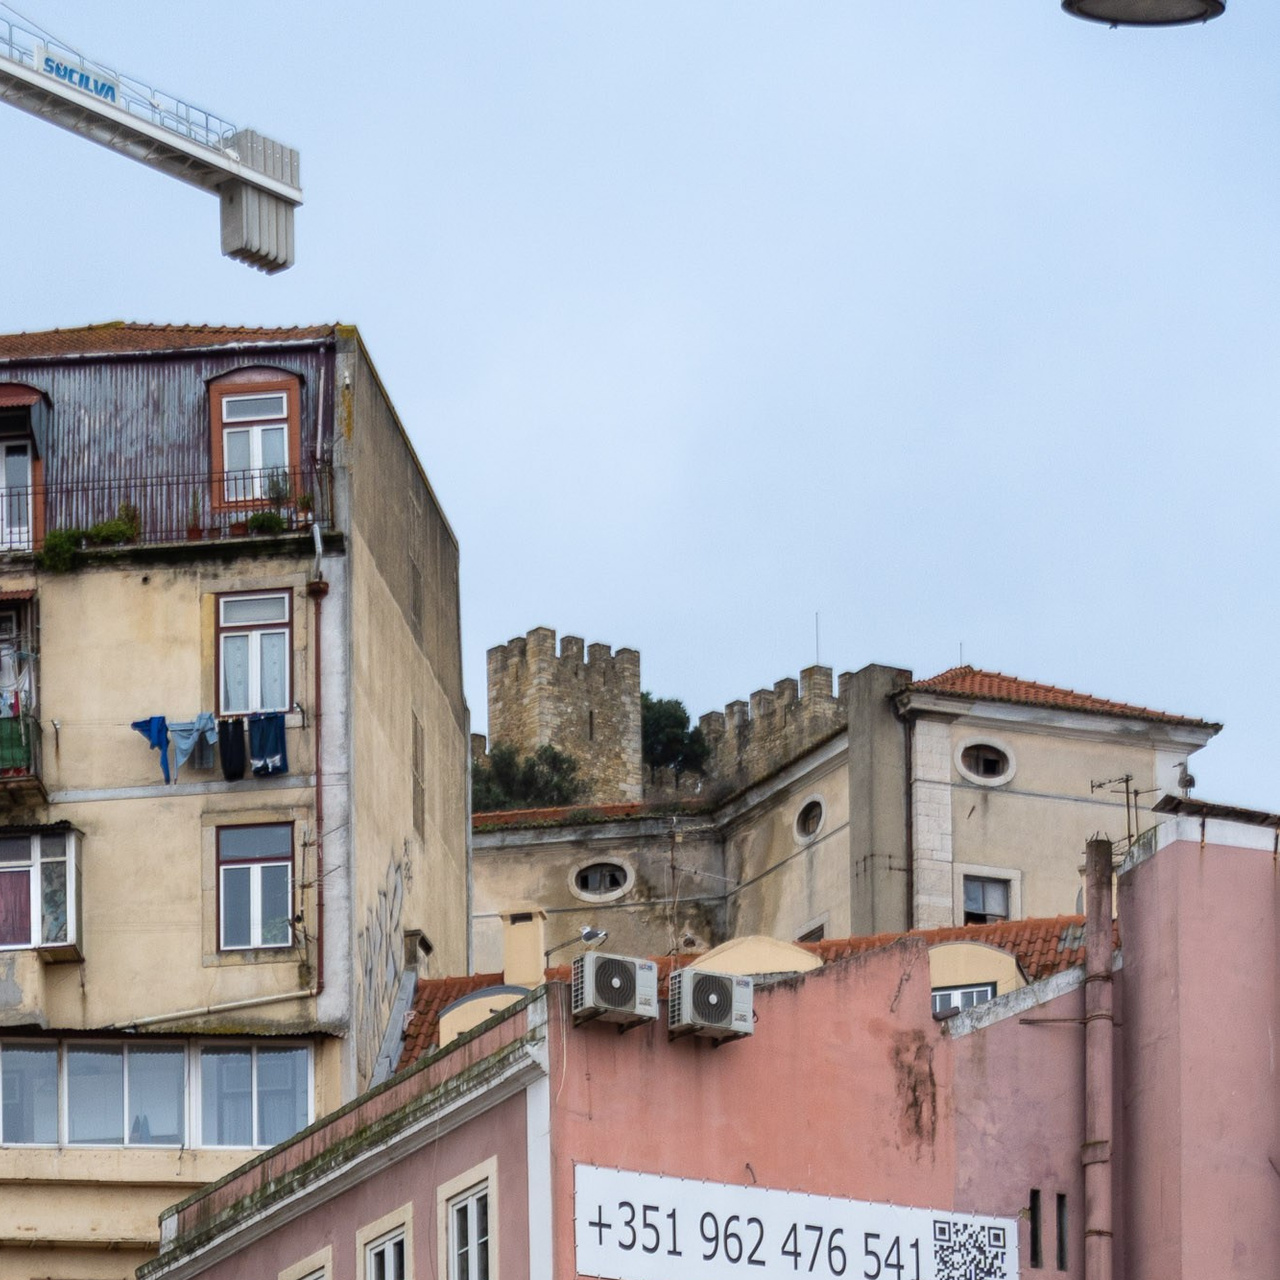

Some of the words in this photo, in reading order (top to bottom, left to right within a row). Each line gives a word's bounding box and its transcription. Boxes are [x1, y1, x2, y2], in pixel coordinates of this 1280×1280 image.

[43, 57, 116, 103] SOCILVA
[589, 1201, 683, 1258] +351
[700, 1212, 766, 1267] 962
[781, 1223, 847, 1277] 476
